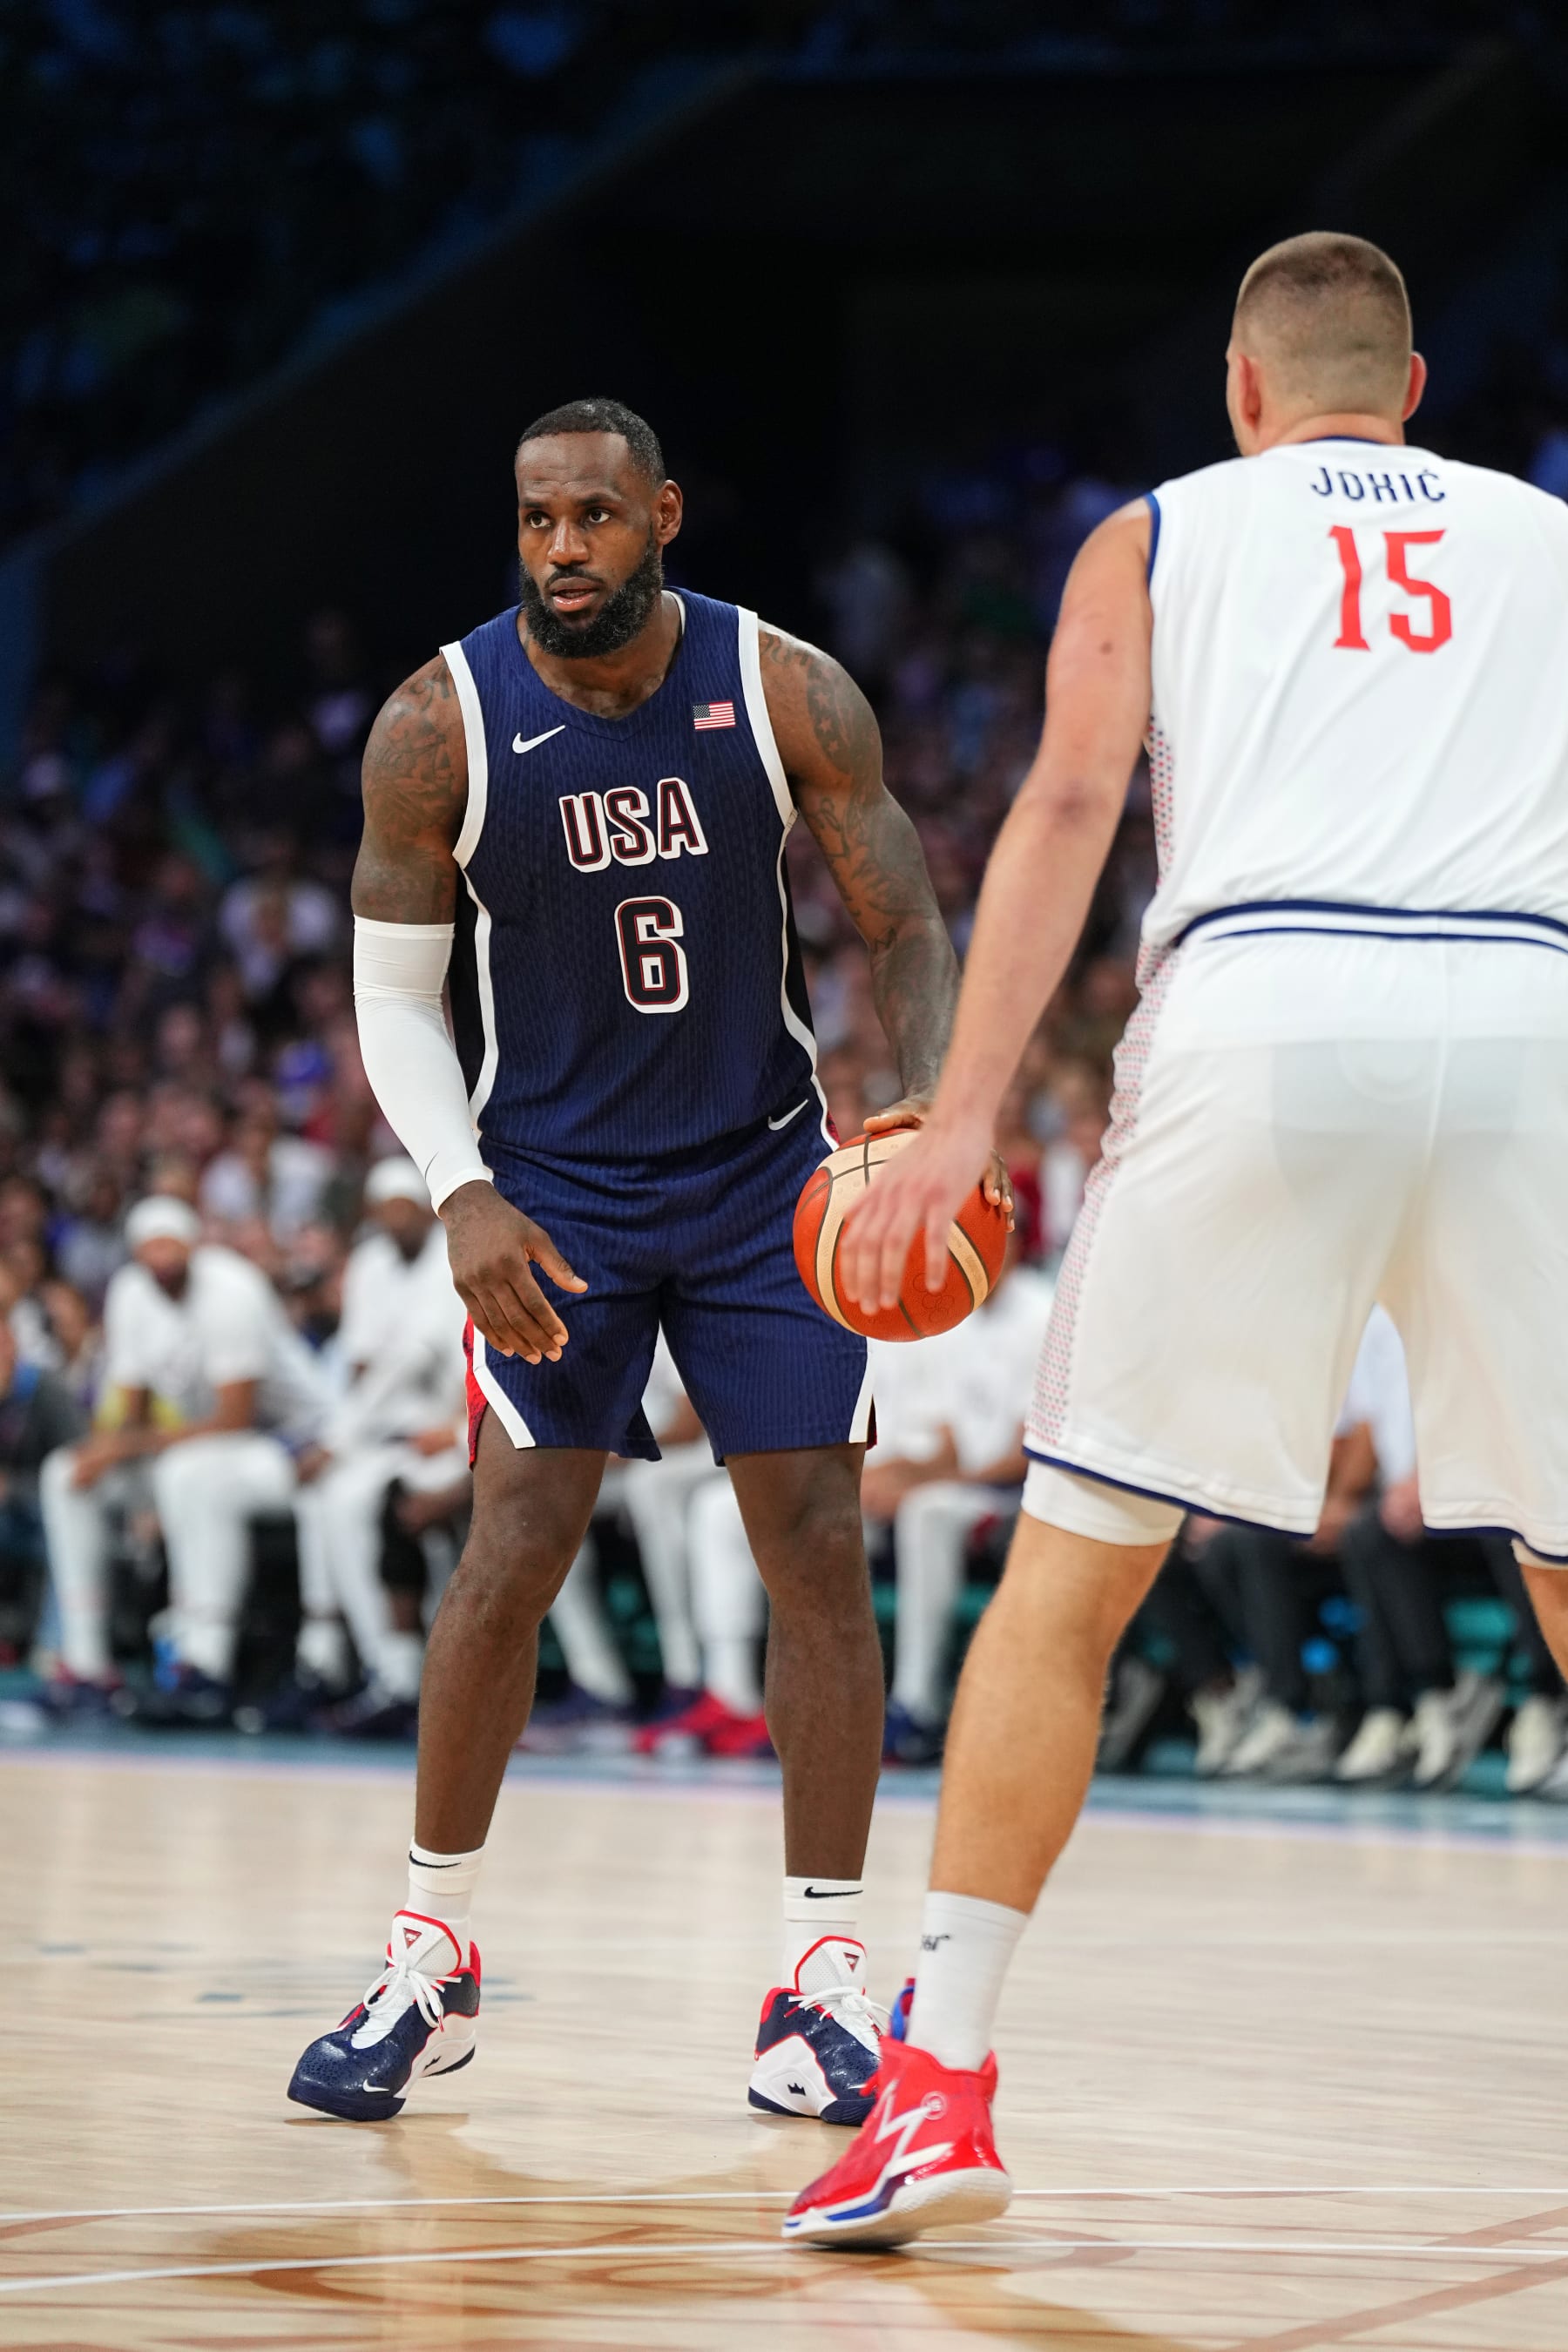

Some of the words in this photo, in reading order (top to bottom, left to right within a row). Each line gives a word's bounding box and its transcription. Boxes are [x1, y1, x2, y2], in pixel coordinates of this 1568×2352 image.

[1328, 525, 1452, 653] 15
[558, 777, 709, 873] USA
[614, 896, 689, 1014] 6
